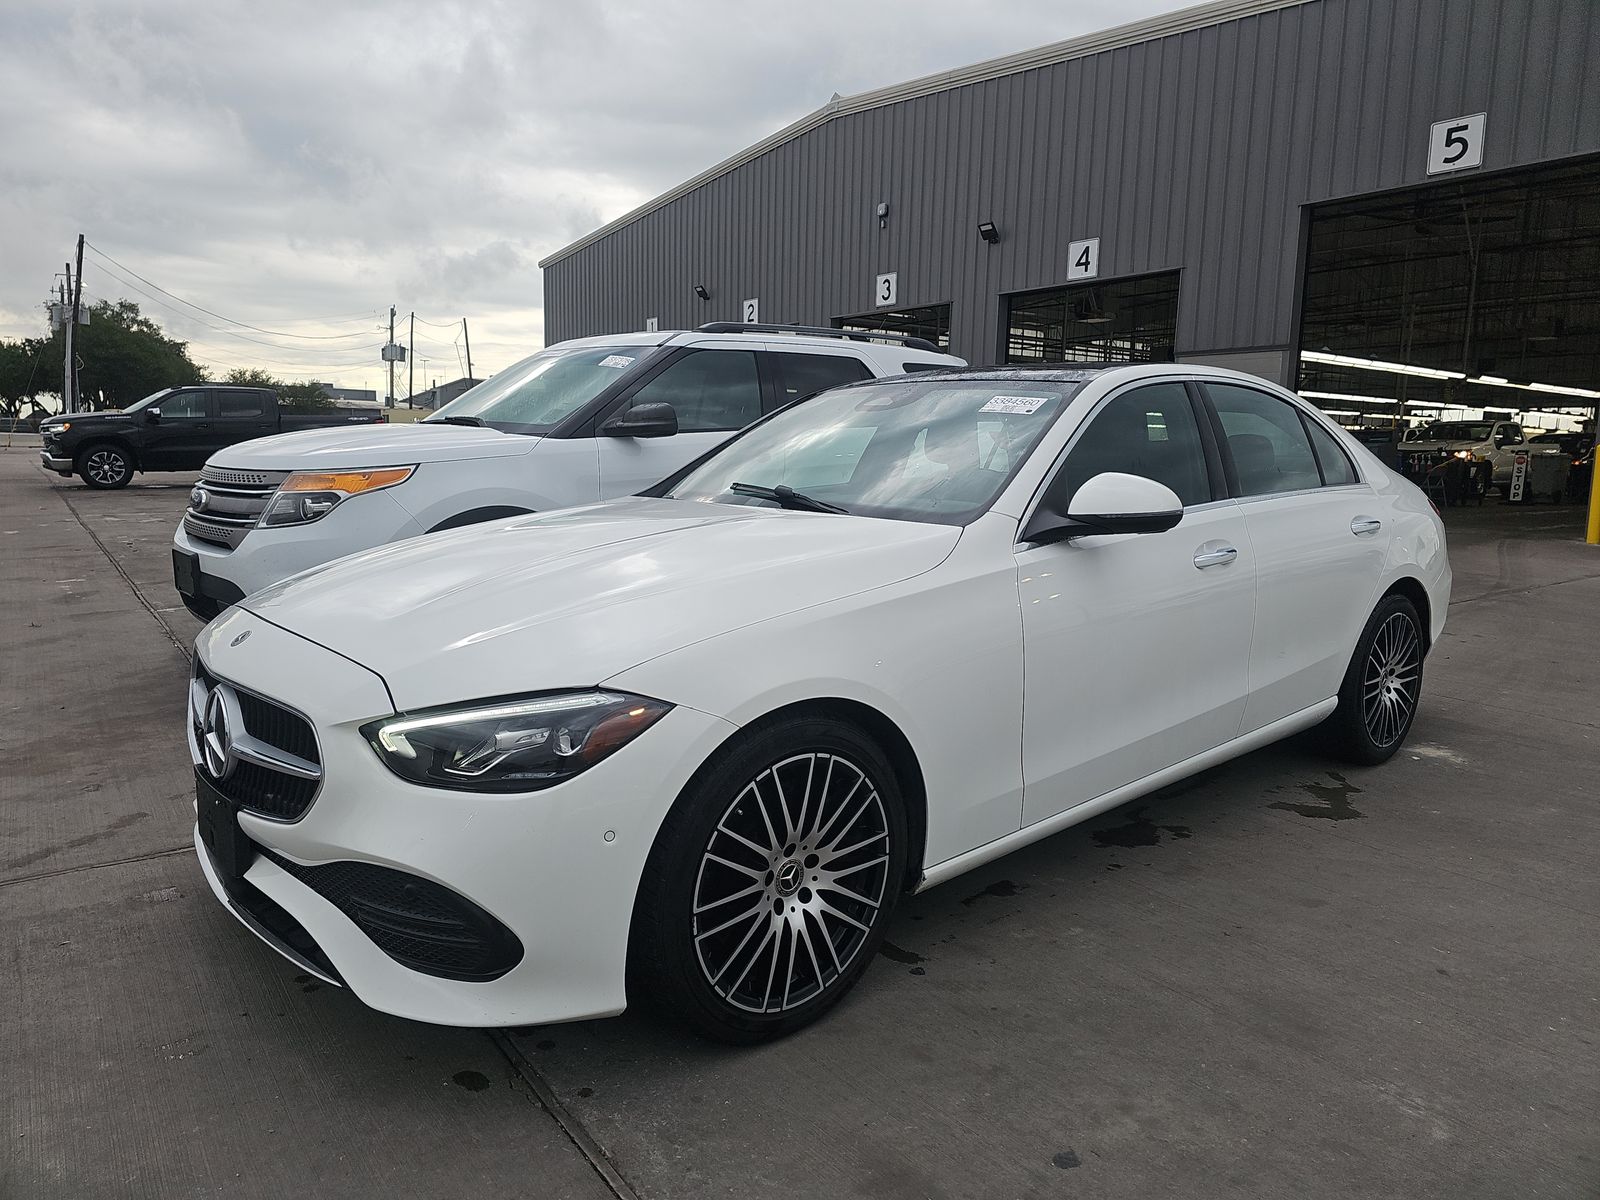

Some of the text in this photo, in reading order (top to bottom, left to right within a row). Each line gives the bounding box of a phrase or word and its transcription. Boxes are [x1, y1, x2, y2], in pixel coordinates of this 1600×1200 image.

[1442, 124, 1469, 163] 5
[1075, 245, 1090, 272] 4
[882, 279, 891, 300] 3
[747, 304, 755, 322] 2
[1512, 467, 1523, 499] STOP
